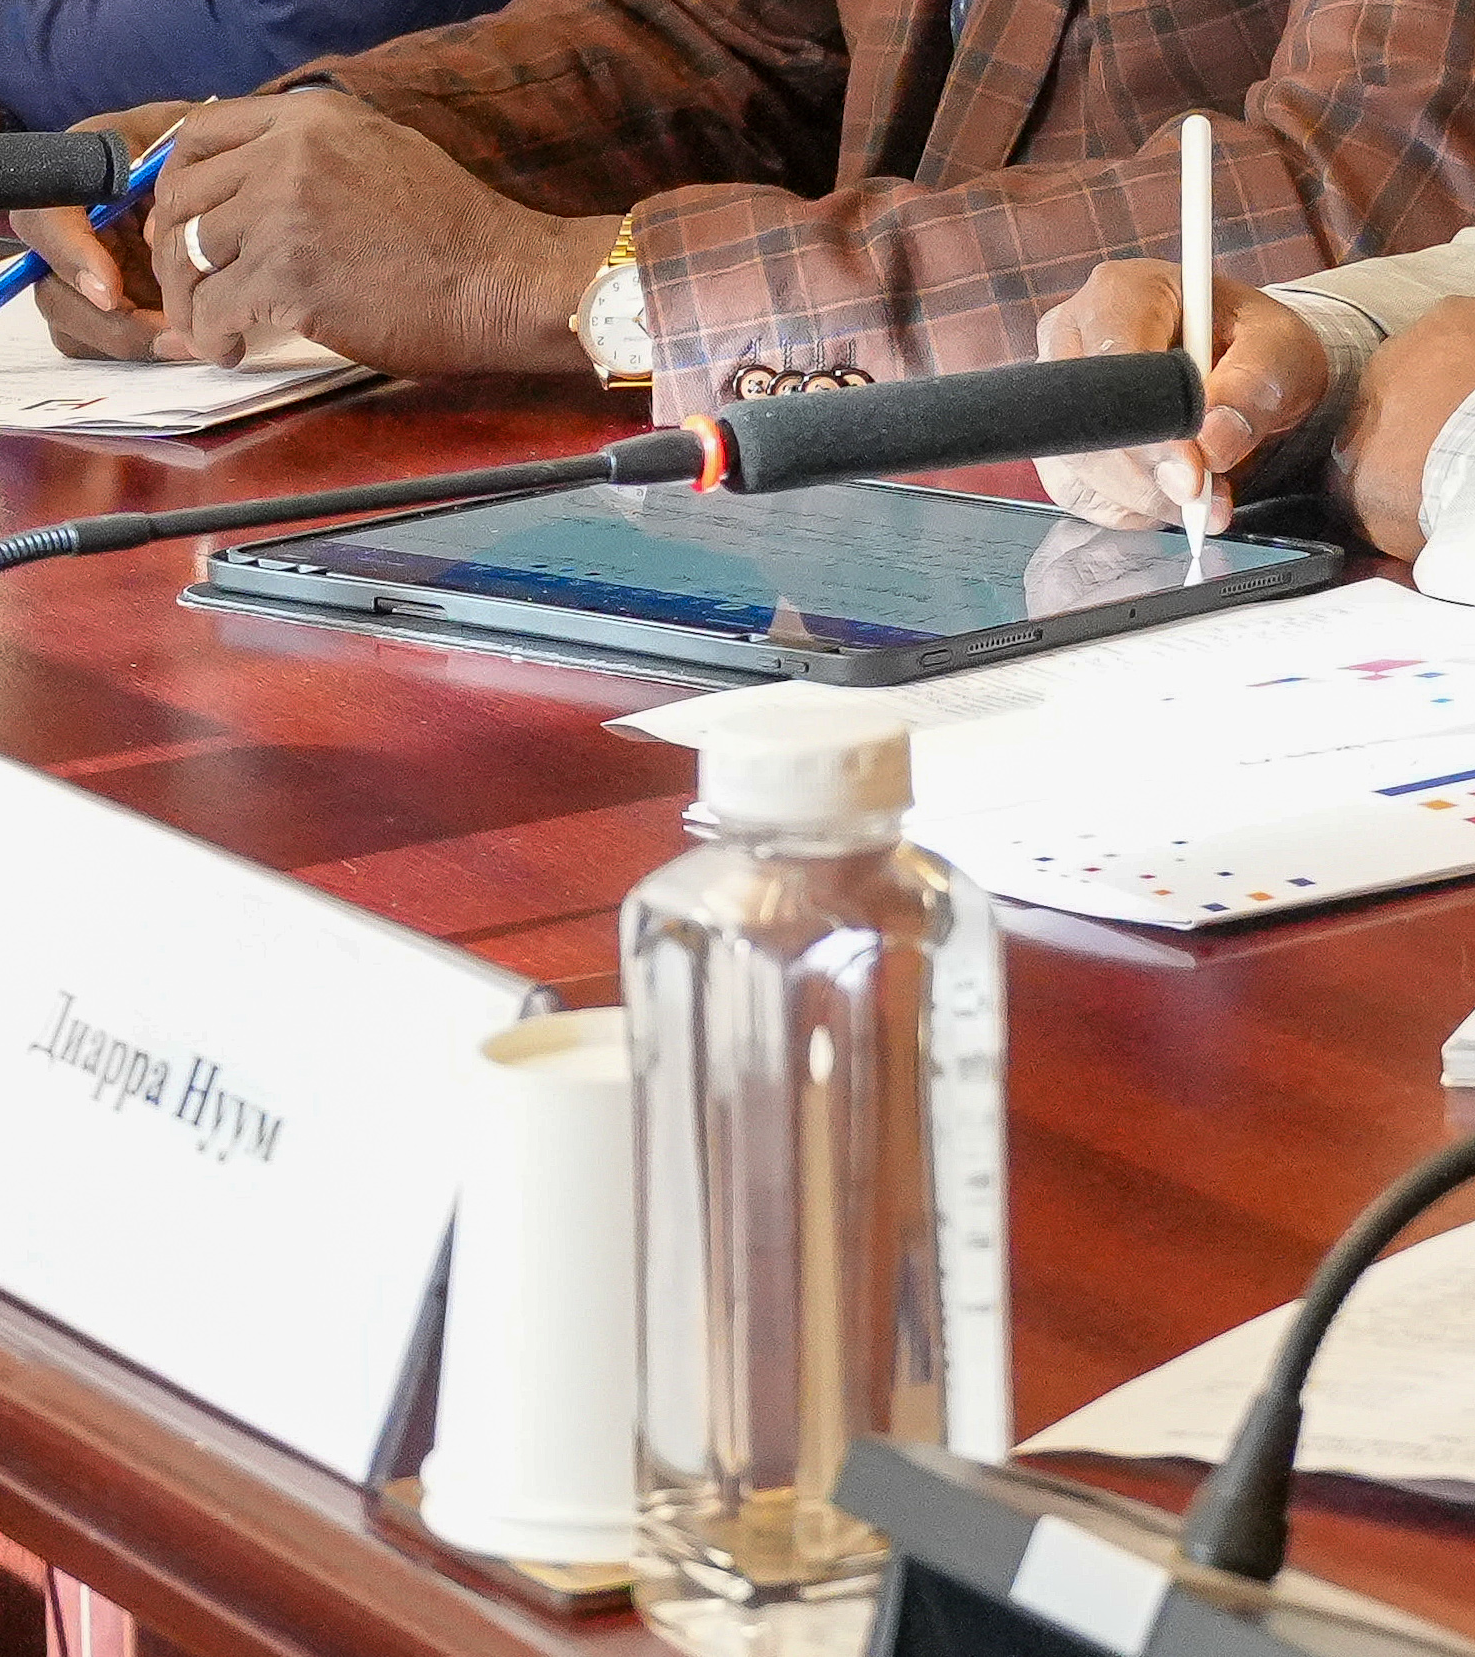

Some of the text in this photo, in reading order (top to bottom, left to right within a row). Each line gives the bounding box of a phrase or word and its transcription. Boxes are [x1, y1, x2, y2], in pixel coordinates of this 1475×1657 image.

[629, 354, 641, 364] 12
[27, 989, 285, 1164] Диарра Нуум
